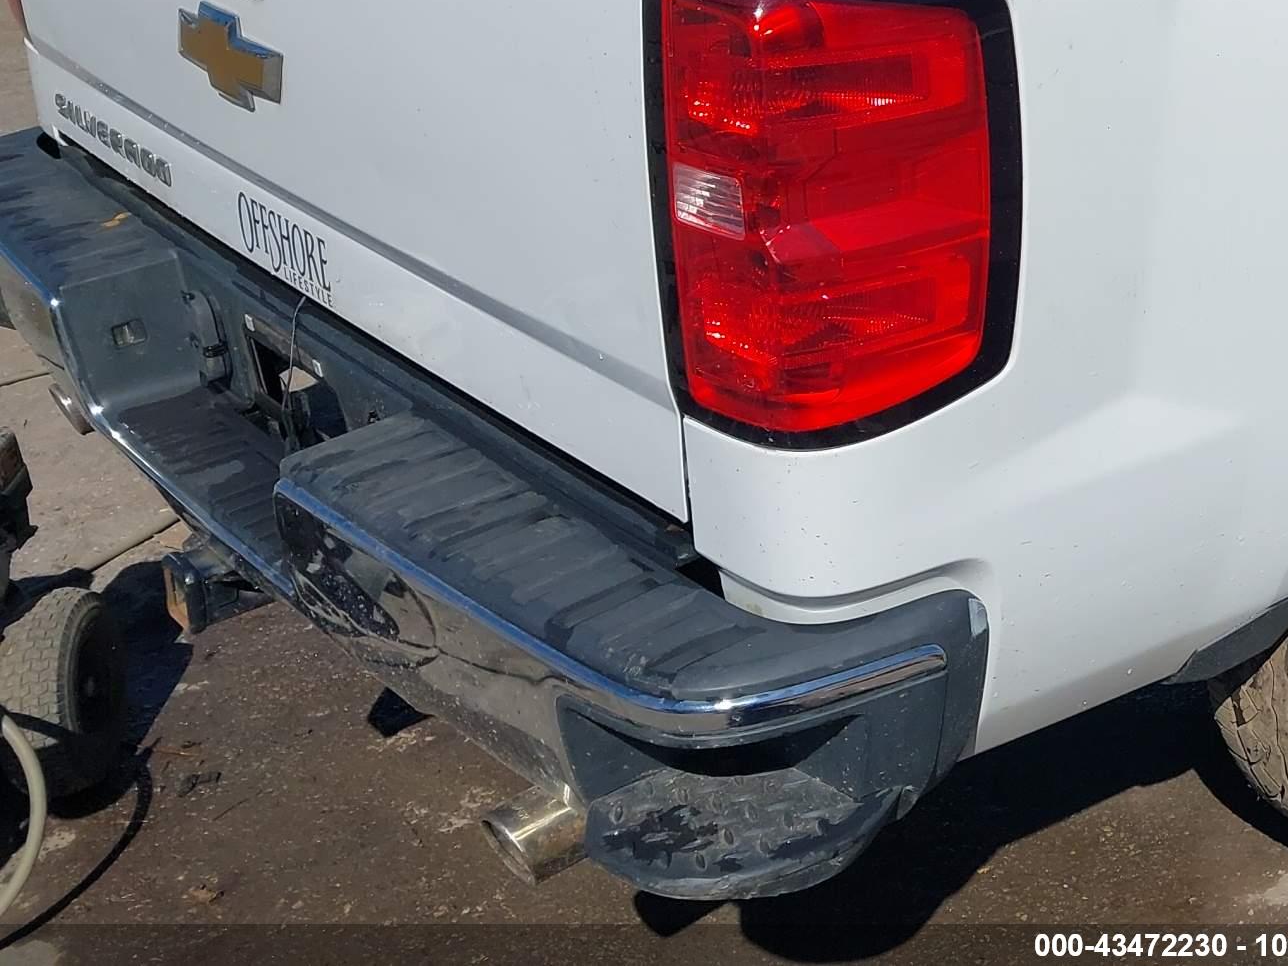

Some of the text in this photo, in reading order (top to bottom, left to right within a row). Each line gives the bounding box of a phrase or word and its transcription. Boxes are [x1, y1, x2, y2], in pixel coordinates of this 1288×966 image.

[54, 93, 172, 187] SILVERADO
[238, 191, 331, 292] OFFSHORE
[283, 266, 333, 308] LIFESTYLE
